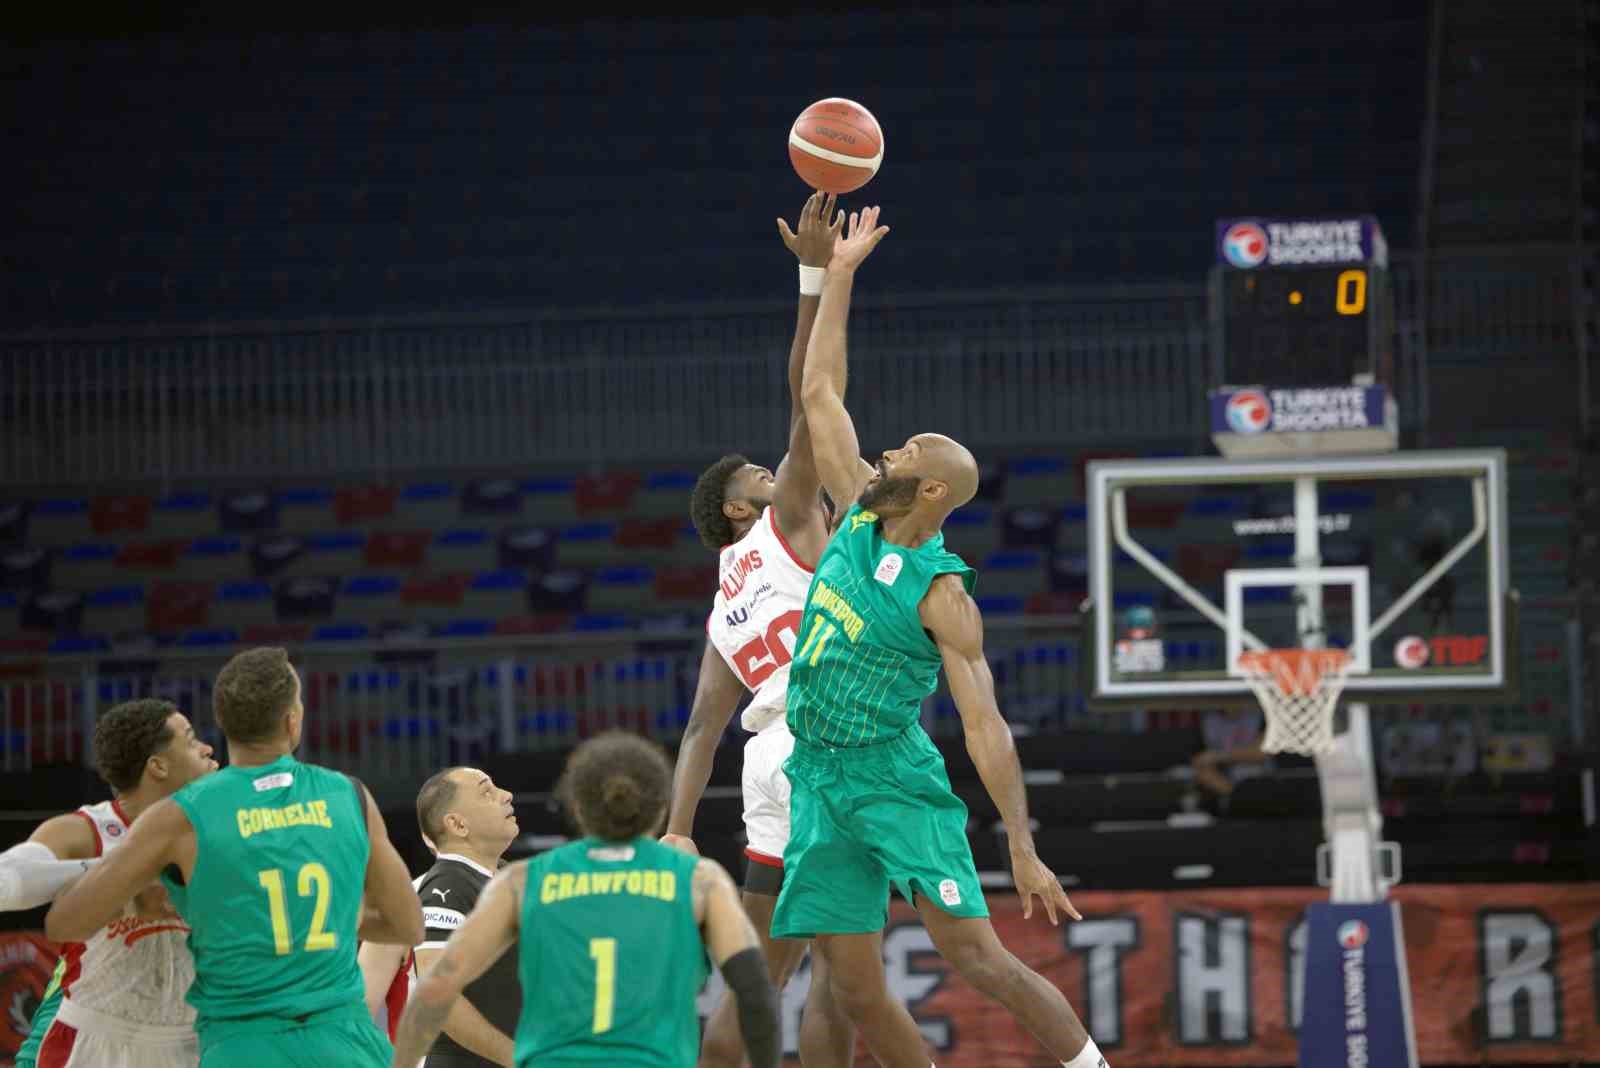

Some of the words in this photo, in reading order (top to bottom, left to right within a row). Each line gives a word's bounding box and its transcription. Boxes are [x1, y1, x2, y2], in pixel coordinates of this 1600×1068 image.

[1336, 270, 1367, 315] 0
[800, 613, 836, 667] 11
[236, 800, 333, 838] CORNELIE
[258, 862, 338, 956] 12
[541, 870, 676, 904] CRAWFORD
[425, 912, 458, 925] DICANA
[589, 937, 617, 1035] 1
